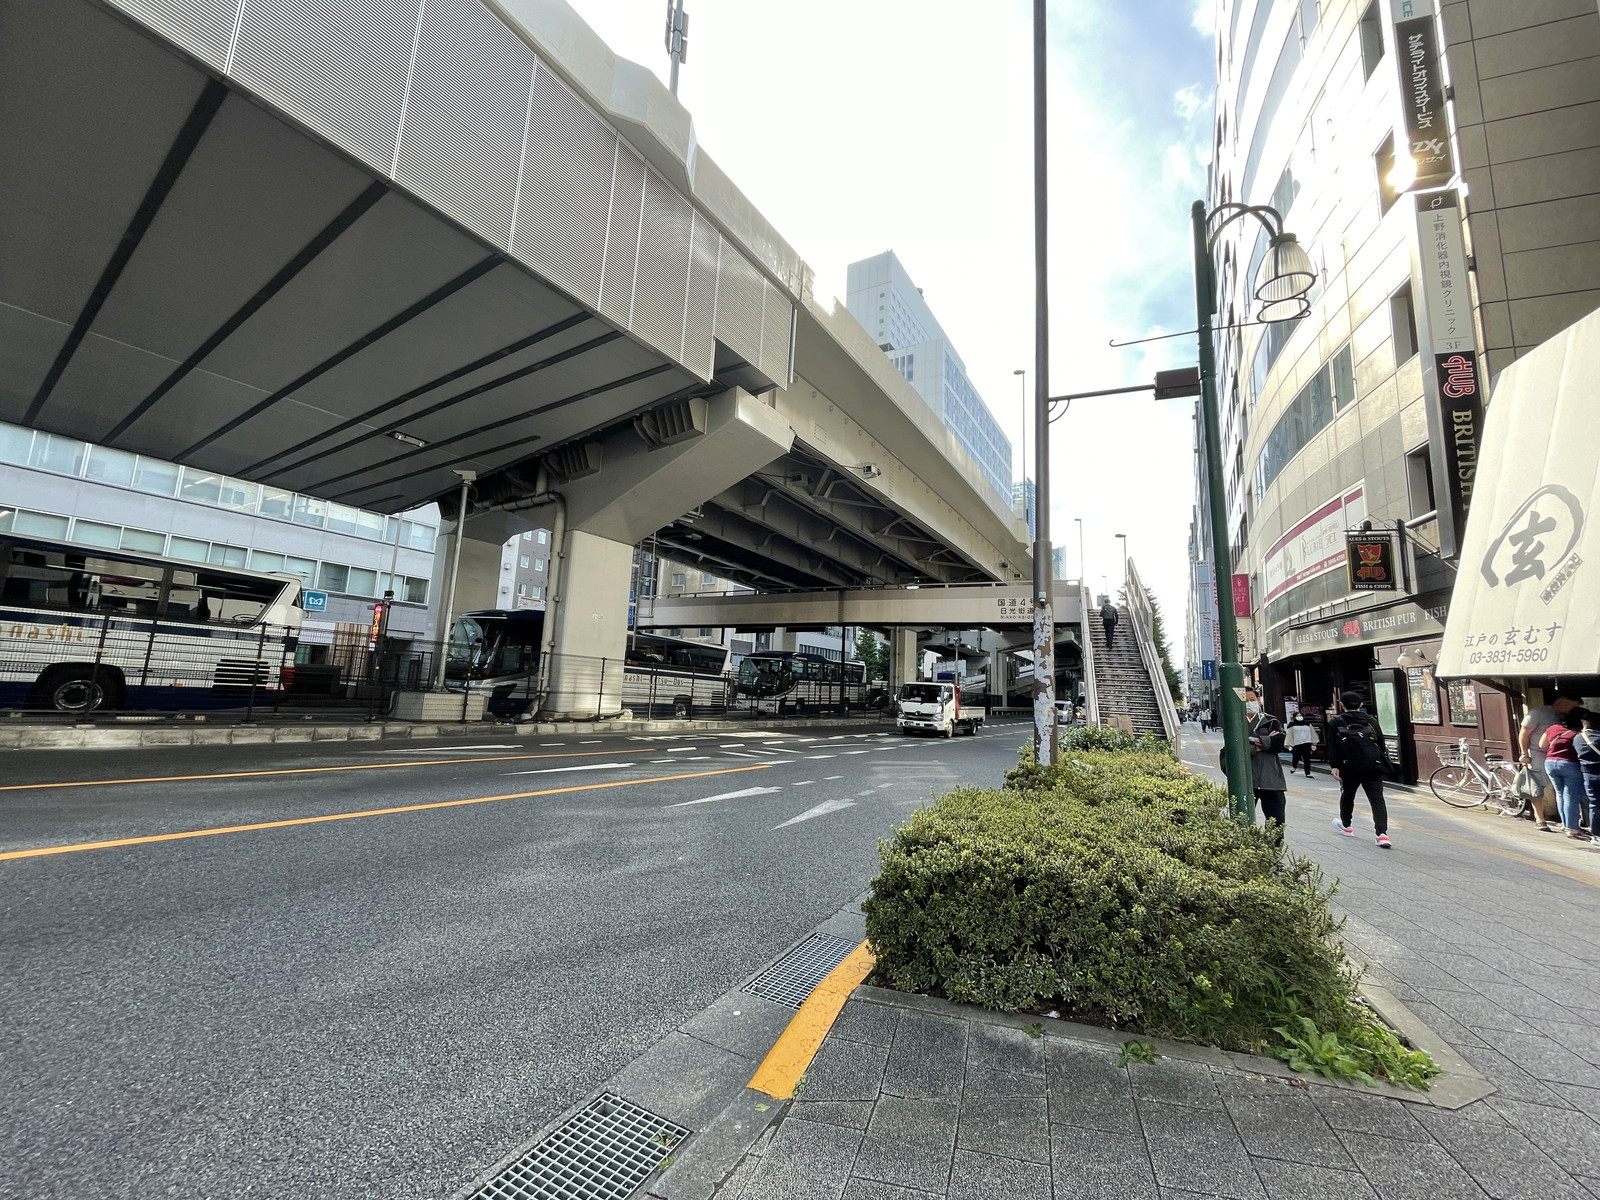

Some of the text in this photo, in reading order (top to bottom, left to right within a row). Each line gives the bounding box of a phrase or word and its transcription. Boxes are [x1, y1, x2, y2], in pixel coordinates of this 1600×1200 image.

[1408, 33, 1433, 130] サテライトオフィスサービス
[1433, 213, 1457, 335] 上野消化器内視鏡クリニック
[1445, 341, 1462, 350] 3F
[1504, 510, 1557, 588] 玄
[0, 623, 83, 642] nashi
[1295, 633, 1309, 644] ALES
[1314, 628, 1338, 642] STOUTS
[1363, 616, 1396, 632] BRITISH
[1398, 612, 1416, 626] PUB
[1424, 606, 1447, 620] FISH
[1470, 648, 1548, 665] 03-3831-5960
